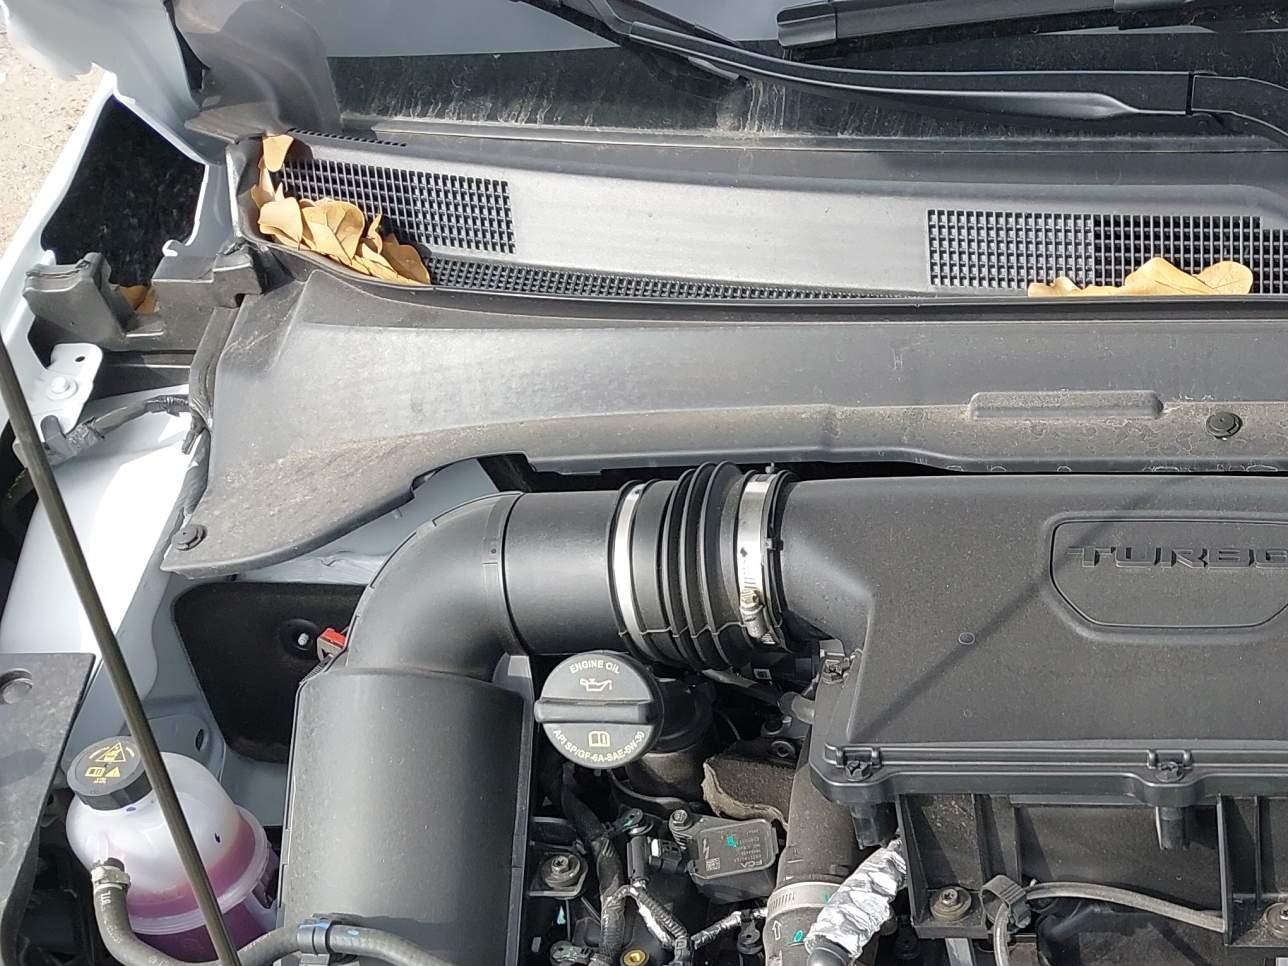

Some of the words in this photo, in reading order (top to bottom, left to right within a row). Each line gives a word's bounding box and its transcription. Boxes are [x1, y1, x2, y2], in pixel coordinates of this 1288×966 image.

[569, 660, 604, 674] ENGINE
[605, 662, 621, 674] OIL
[553, 729, 566, 745] API
